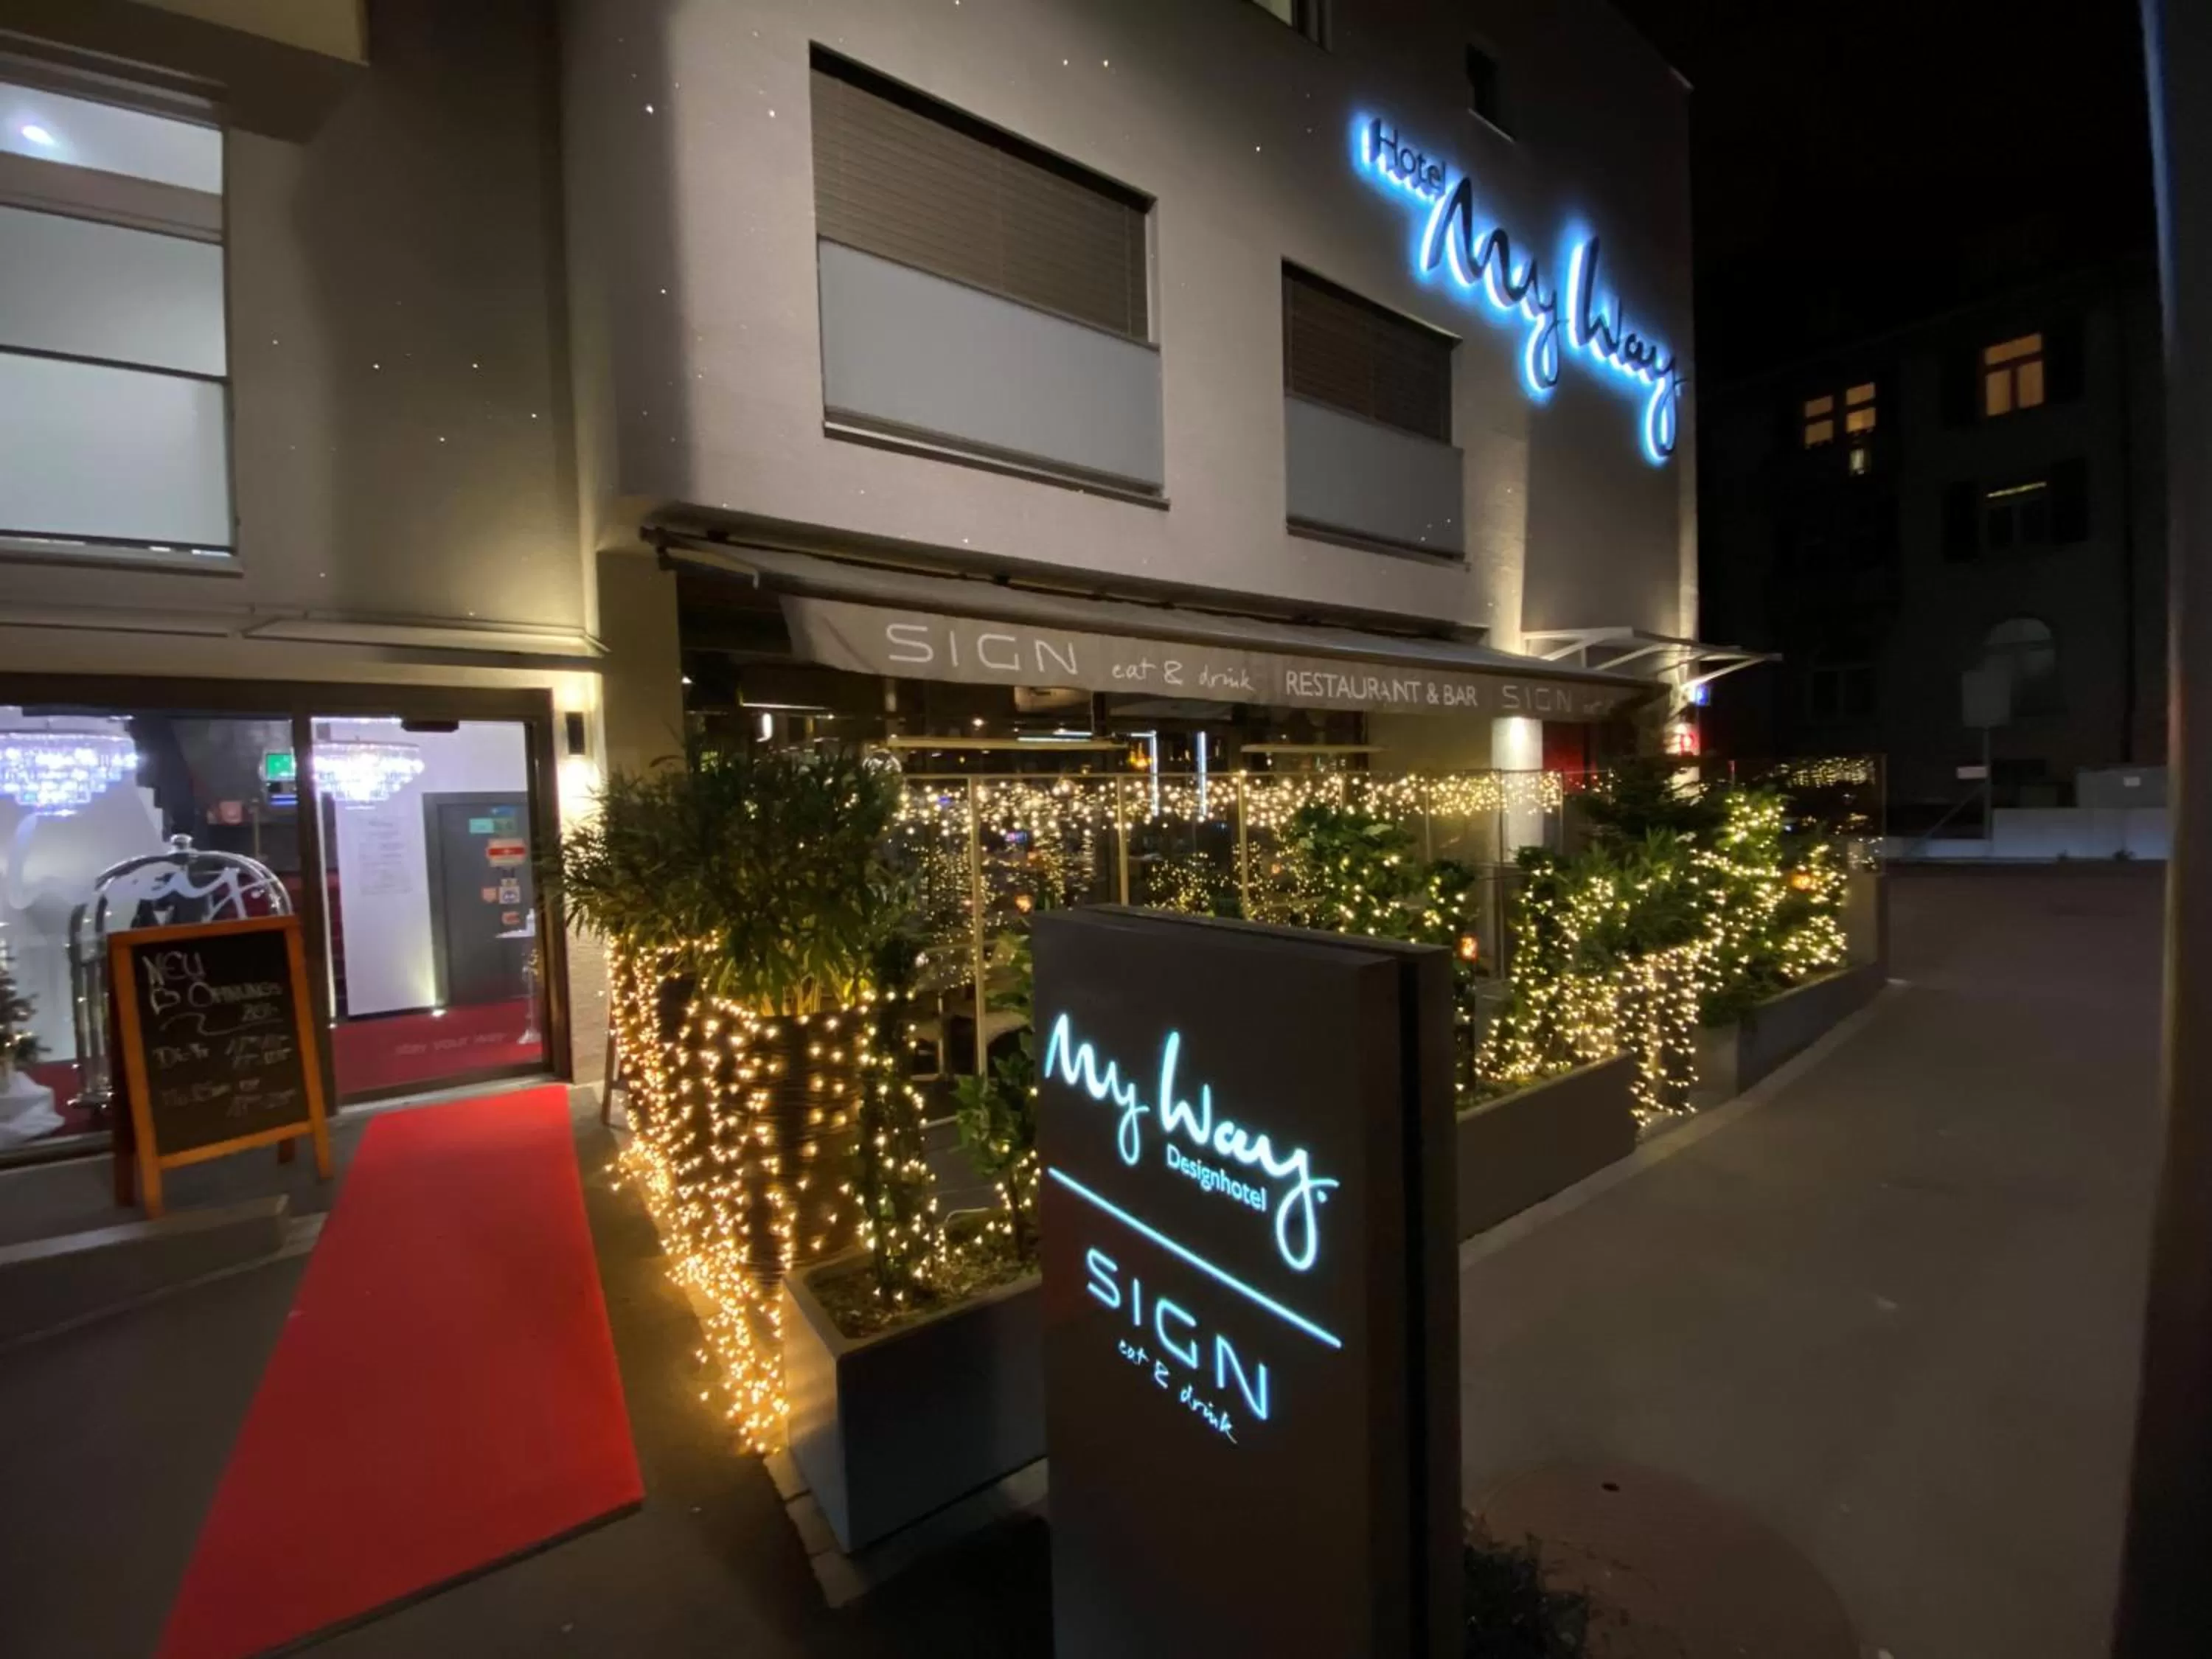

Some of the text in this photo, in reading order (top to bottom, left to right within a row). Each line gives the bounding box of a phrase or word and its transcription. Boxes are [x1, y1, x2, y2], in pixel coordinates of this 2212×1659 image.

[1366, 118, 1447, 193] Hotel
[1422, 177, 1571, 389] My
[886, 623, 1078, 675] SIGN
[1112, 657, 1157, 680] eat
[1164, 661, 1183, 685] &
[1199, 664, 1256, 692] drink
[1286, 669, 1422, 705] RESTAURANT
[1426, 683, 1439, 705] &
[1444, 684, 1478, 707] BAR
[1502, 685, 1573, 713] SIGN
[1045, 1013, 1150, 1167] My
[1166, 1144, 1267, 1212] Designhotel
[1086, 1247, 1267, 1421] SIGN
[1118, 1339, 1150, 1366] eat
[1180, 1383, 1238, 1444] drink
